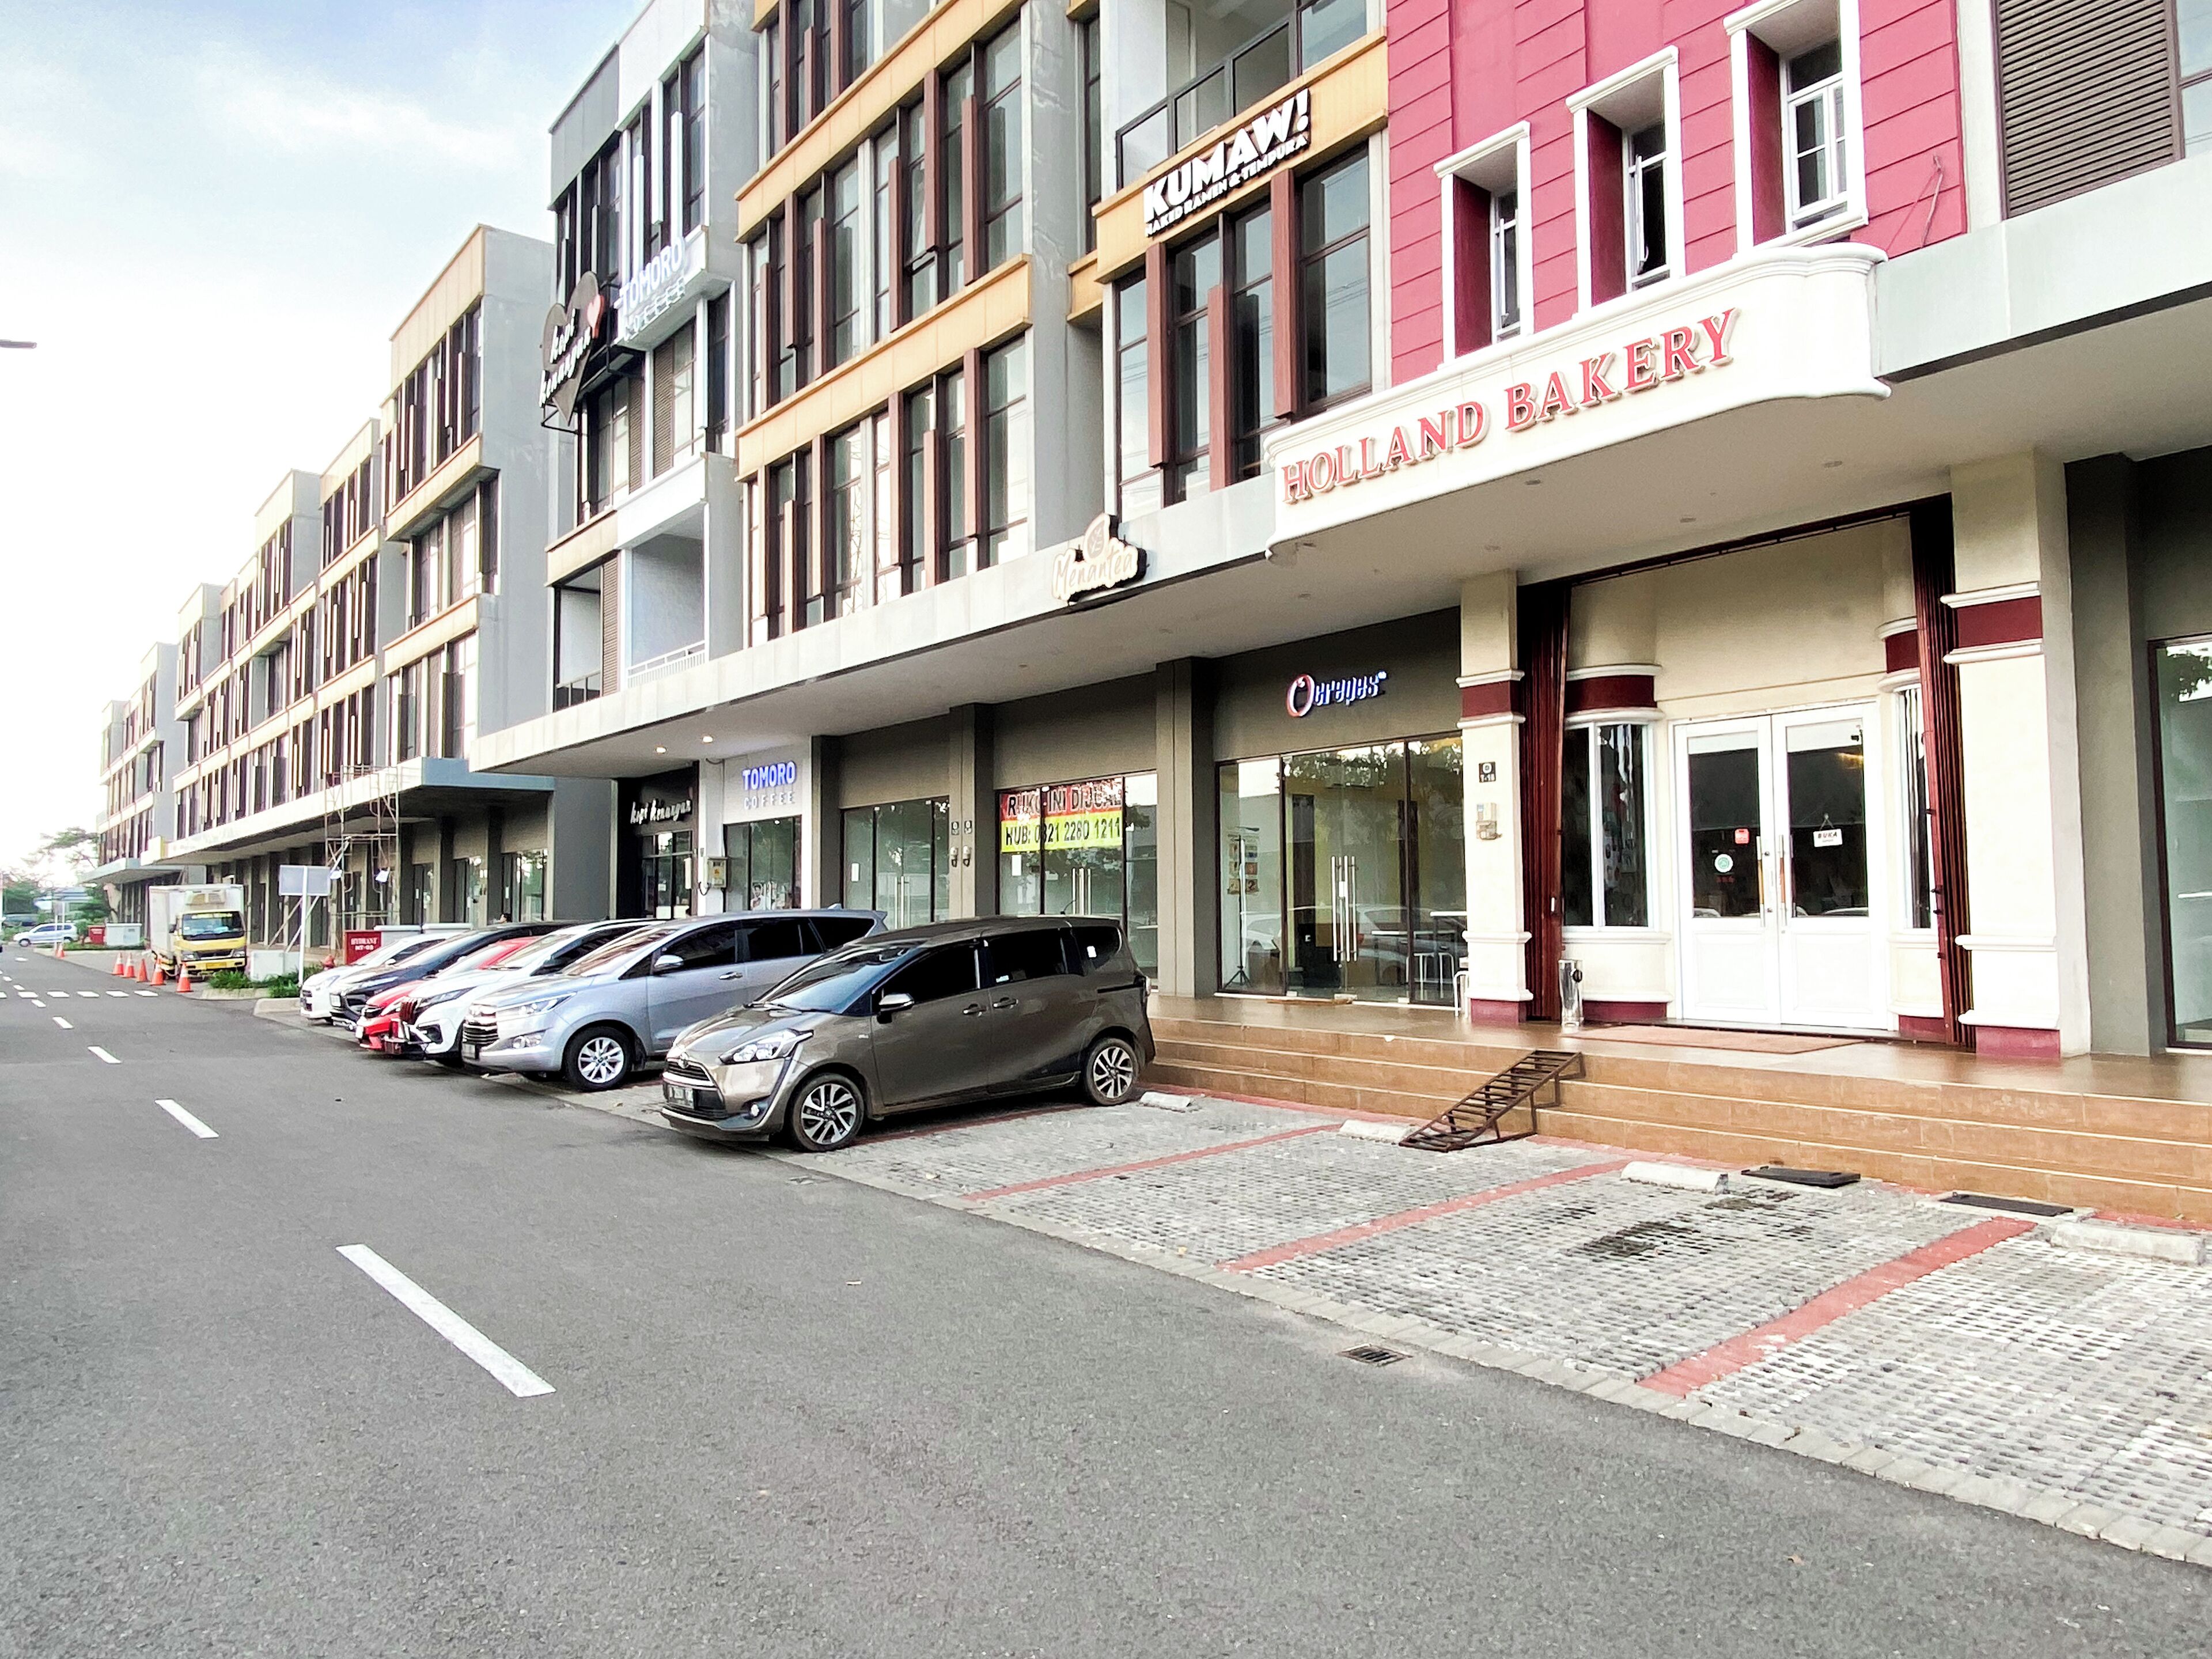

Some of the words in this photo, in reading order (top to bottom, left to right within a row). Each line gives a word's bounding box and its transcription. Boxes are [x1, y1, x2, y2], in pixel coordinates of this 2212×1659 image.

[1143, 88, 1310, 224] KUMAW!
[1184, 179, 1228, 215] RAMEN
[1229, 172, 1241, 188] &
[1241, 133, 1308, 180] TEMPURA
[619, 237, 685, 317] TOMORO
[1281, 400, 1490, 505] HOLLAND
[1505, 307, 1741, 432] BAKERY
[1054, 543, 1133, 598] Menantea
[743, 761, 796, 791] TOMORO
[744, 791, 795, 810] COFFEE
[1006, 825, 1030, 846] HUB:
[1094, 816, 1120, 839] 1211
